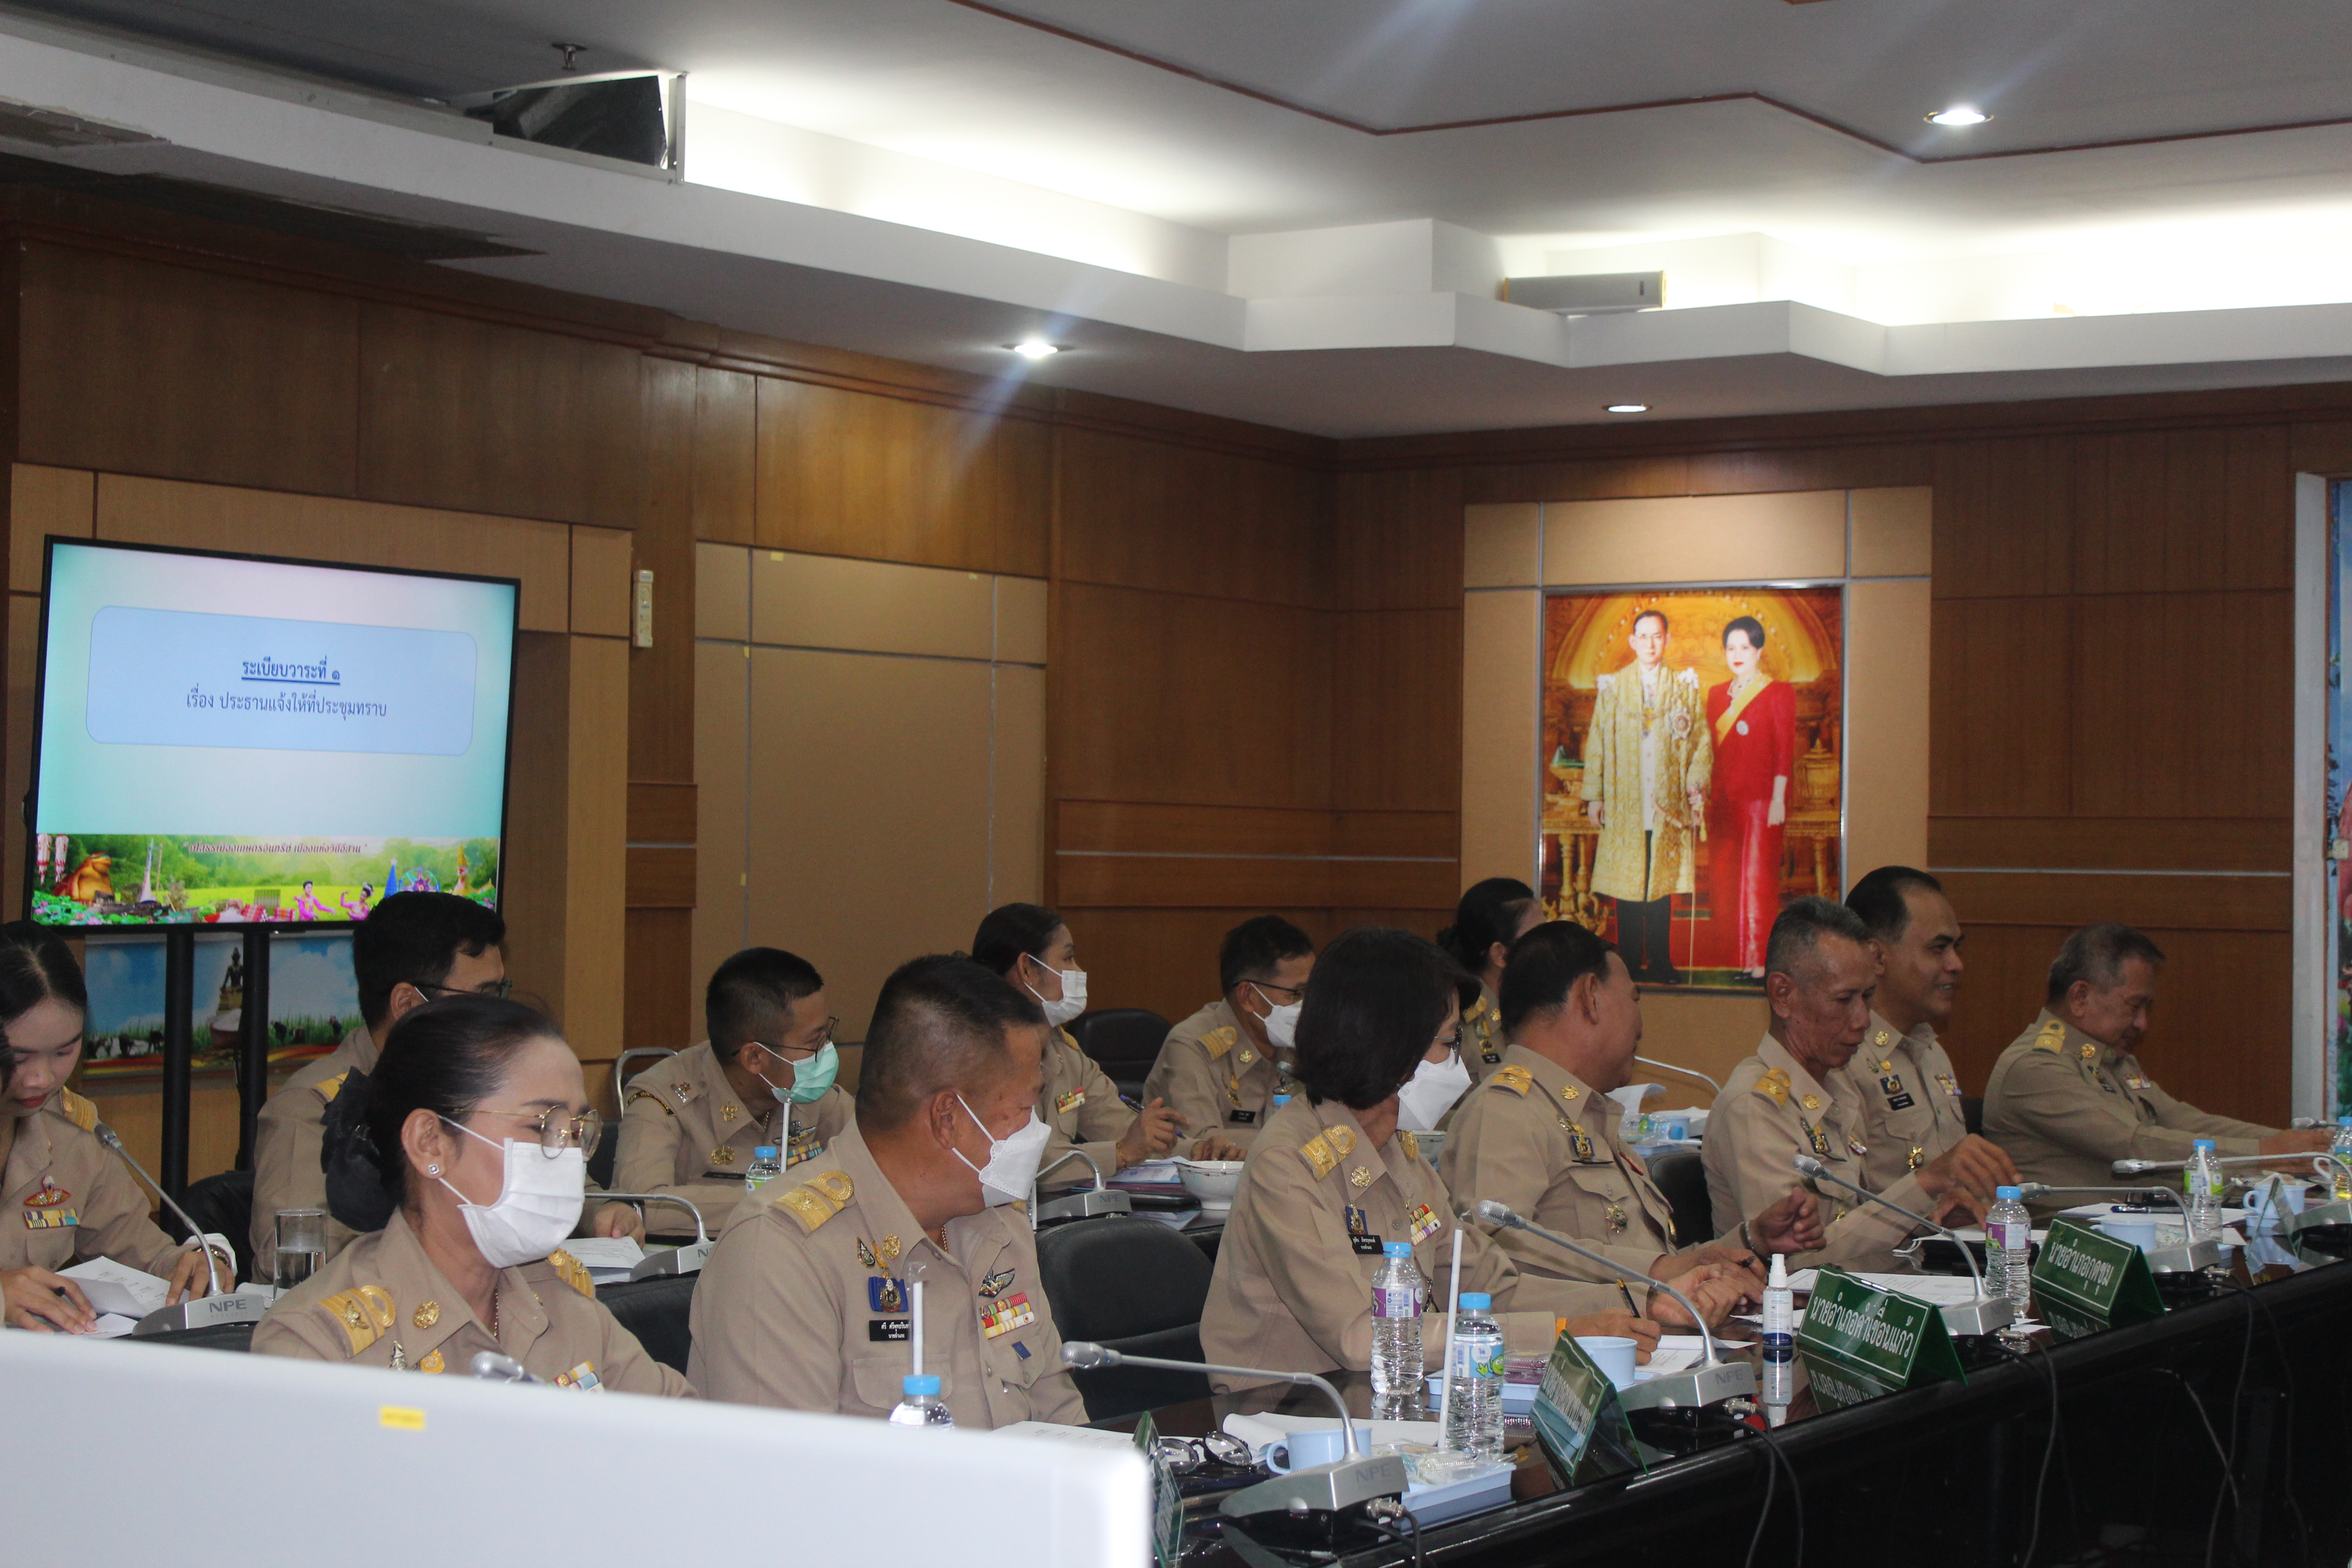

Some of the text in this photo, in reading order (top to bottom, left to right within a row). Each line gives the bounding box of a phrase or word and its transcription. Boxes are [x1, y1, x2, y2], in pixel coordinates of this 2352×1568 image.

[242, 655, 340, 680] ระเบียบวาระที่ ๑
[187, 683, 387, 720] เรื่อง ประธานแจ้งให้ที่ประชุมทราบ
[2048, 1238, 2114, 1296] นายอำเภอกุดชุม
[209, 1299, 247, 1313] NPE
[1810, 1292, 1914, 1358] นายอำเภอคำเขื่อนแก้ว
[1715, 1369, 1743, 1385] NPE
[1355, 1463, 1391, 1483] NPE
